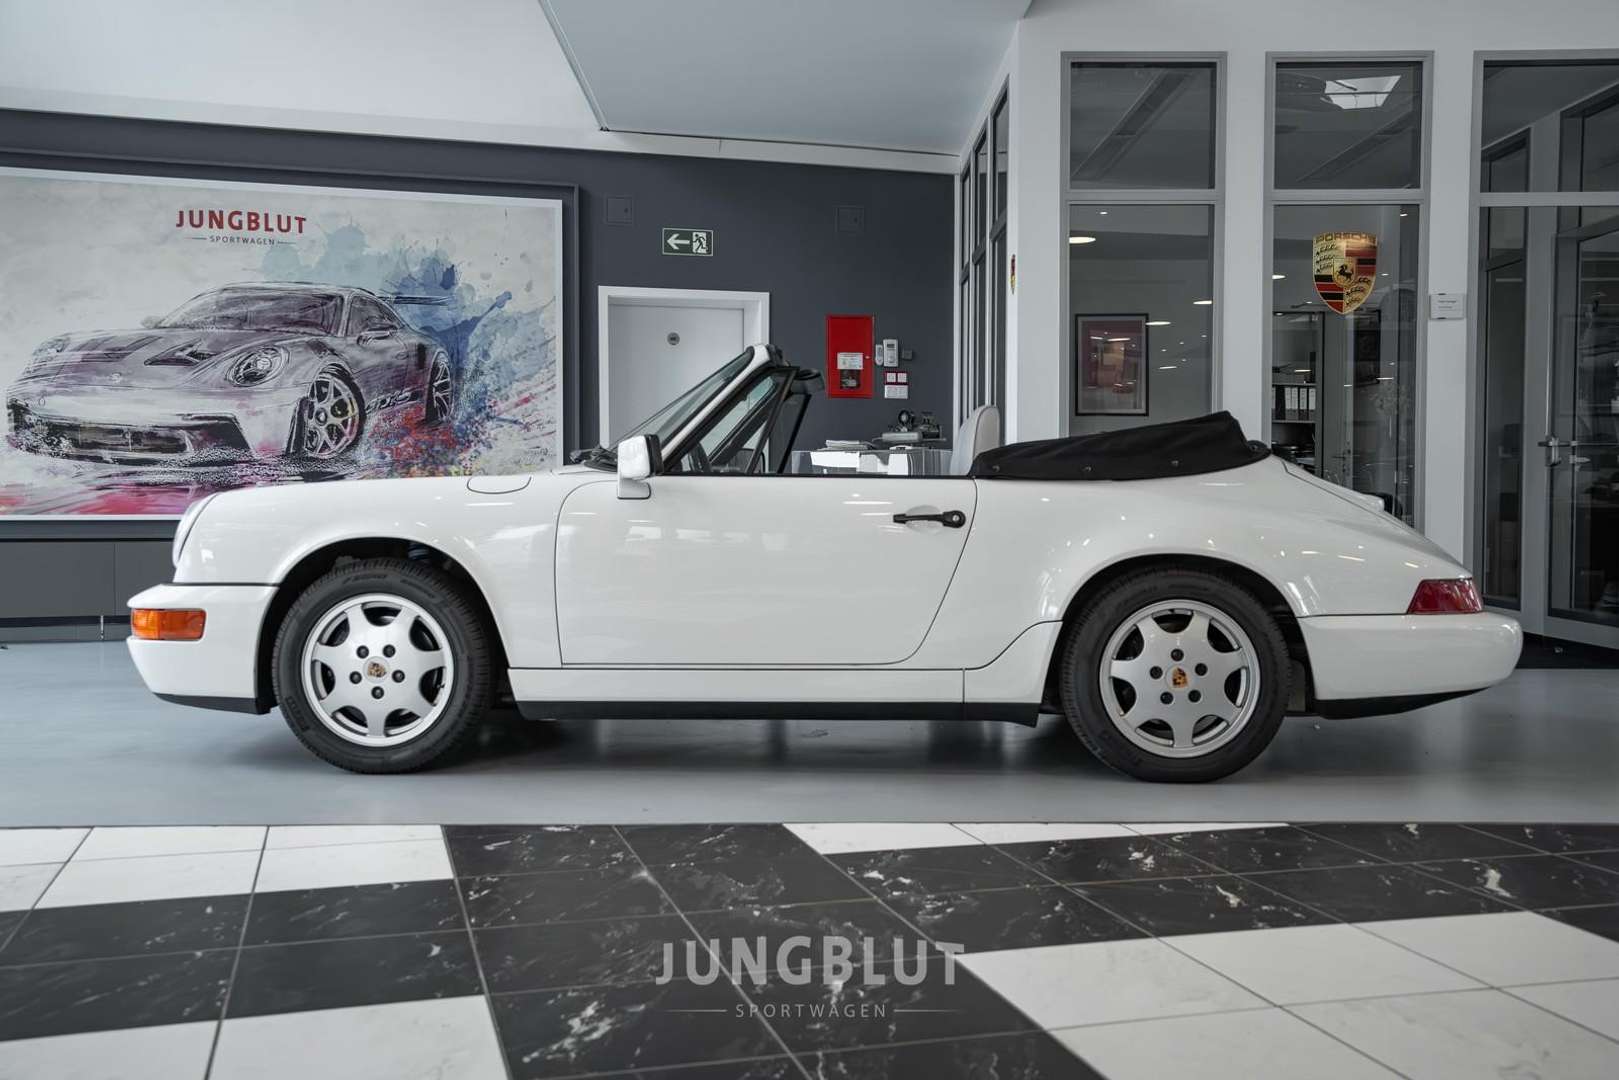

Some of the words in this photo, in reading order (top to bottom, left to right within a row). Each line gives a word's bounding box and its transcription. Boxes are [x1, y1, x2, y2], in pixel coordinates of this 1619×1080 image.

[176, 210, 307, 234] JUNGBLUT
[209, 235, 275, 246] SPORTWAGEN
[1315, 232, 1377, 245] PORSCHE
